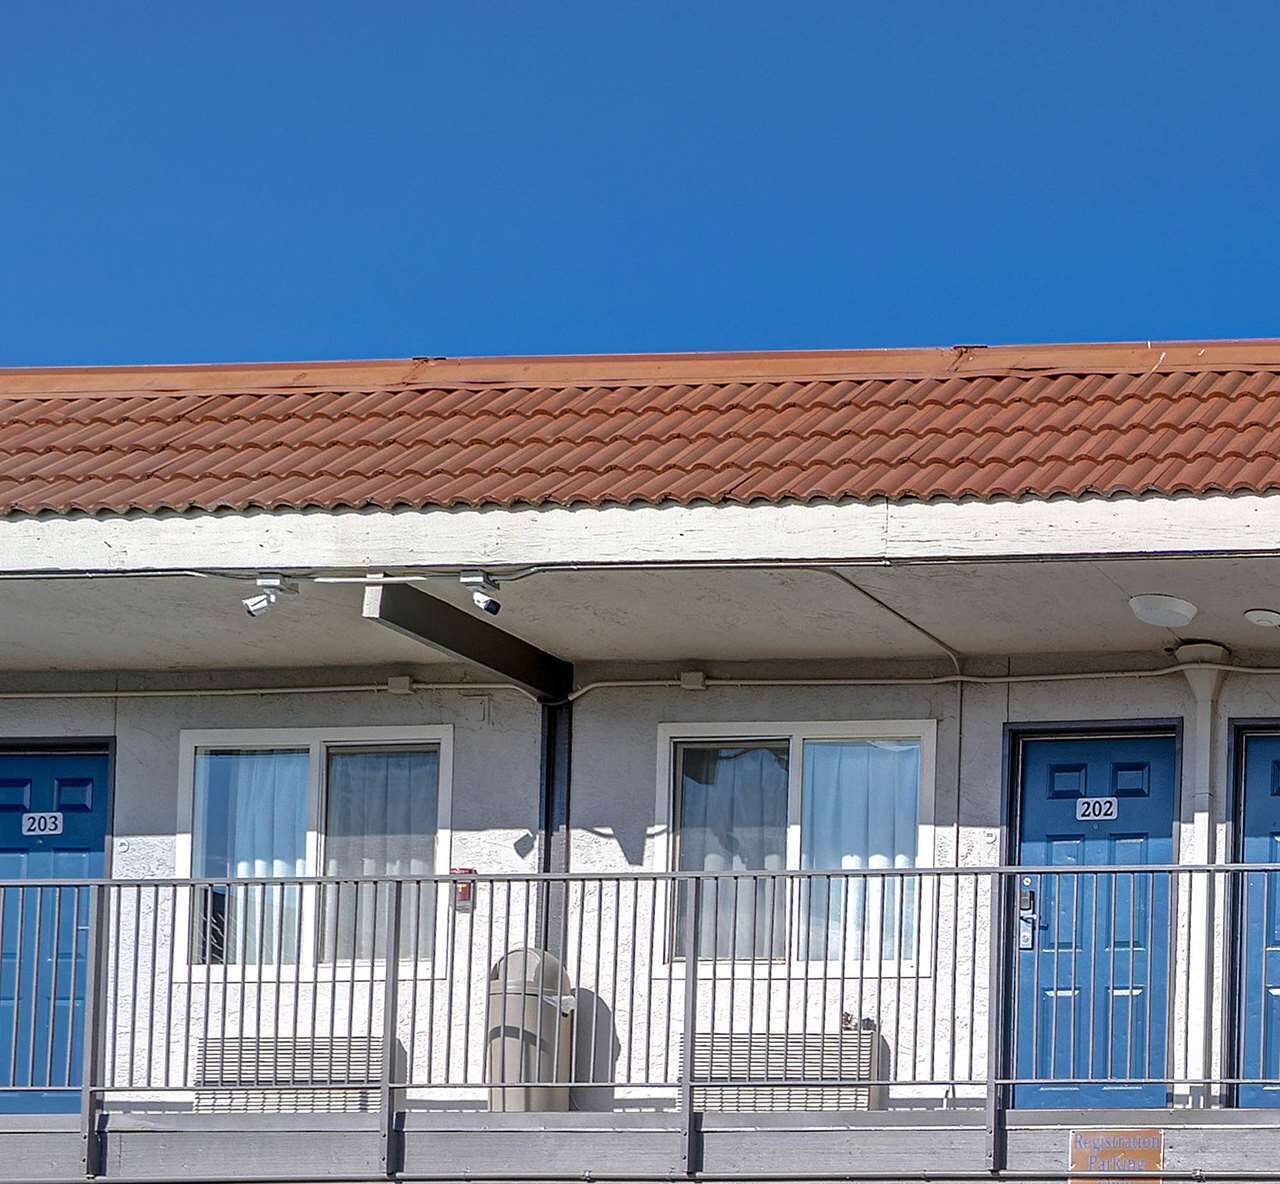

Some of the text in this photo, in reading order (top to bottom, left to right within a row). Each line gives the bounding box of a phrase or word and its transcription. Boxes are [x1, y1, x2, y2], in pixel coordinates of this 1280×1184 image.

[1080, 800, 1113, 817] 202
[26, 815, 59, 832] 203
[1074, 1134, 1160, 1150] Registration
[1088, 1154, 1145, 1171] Parking
